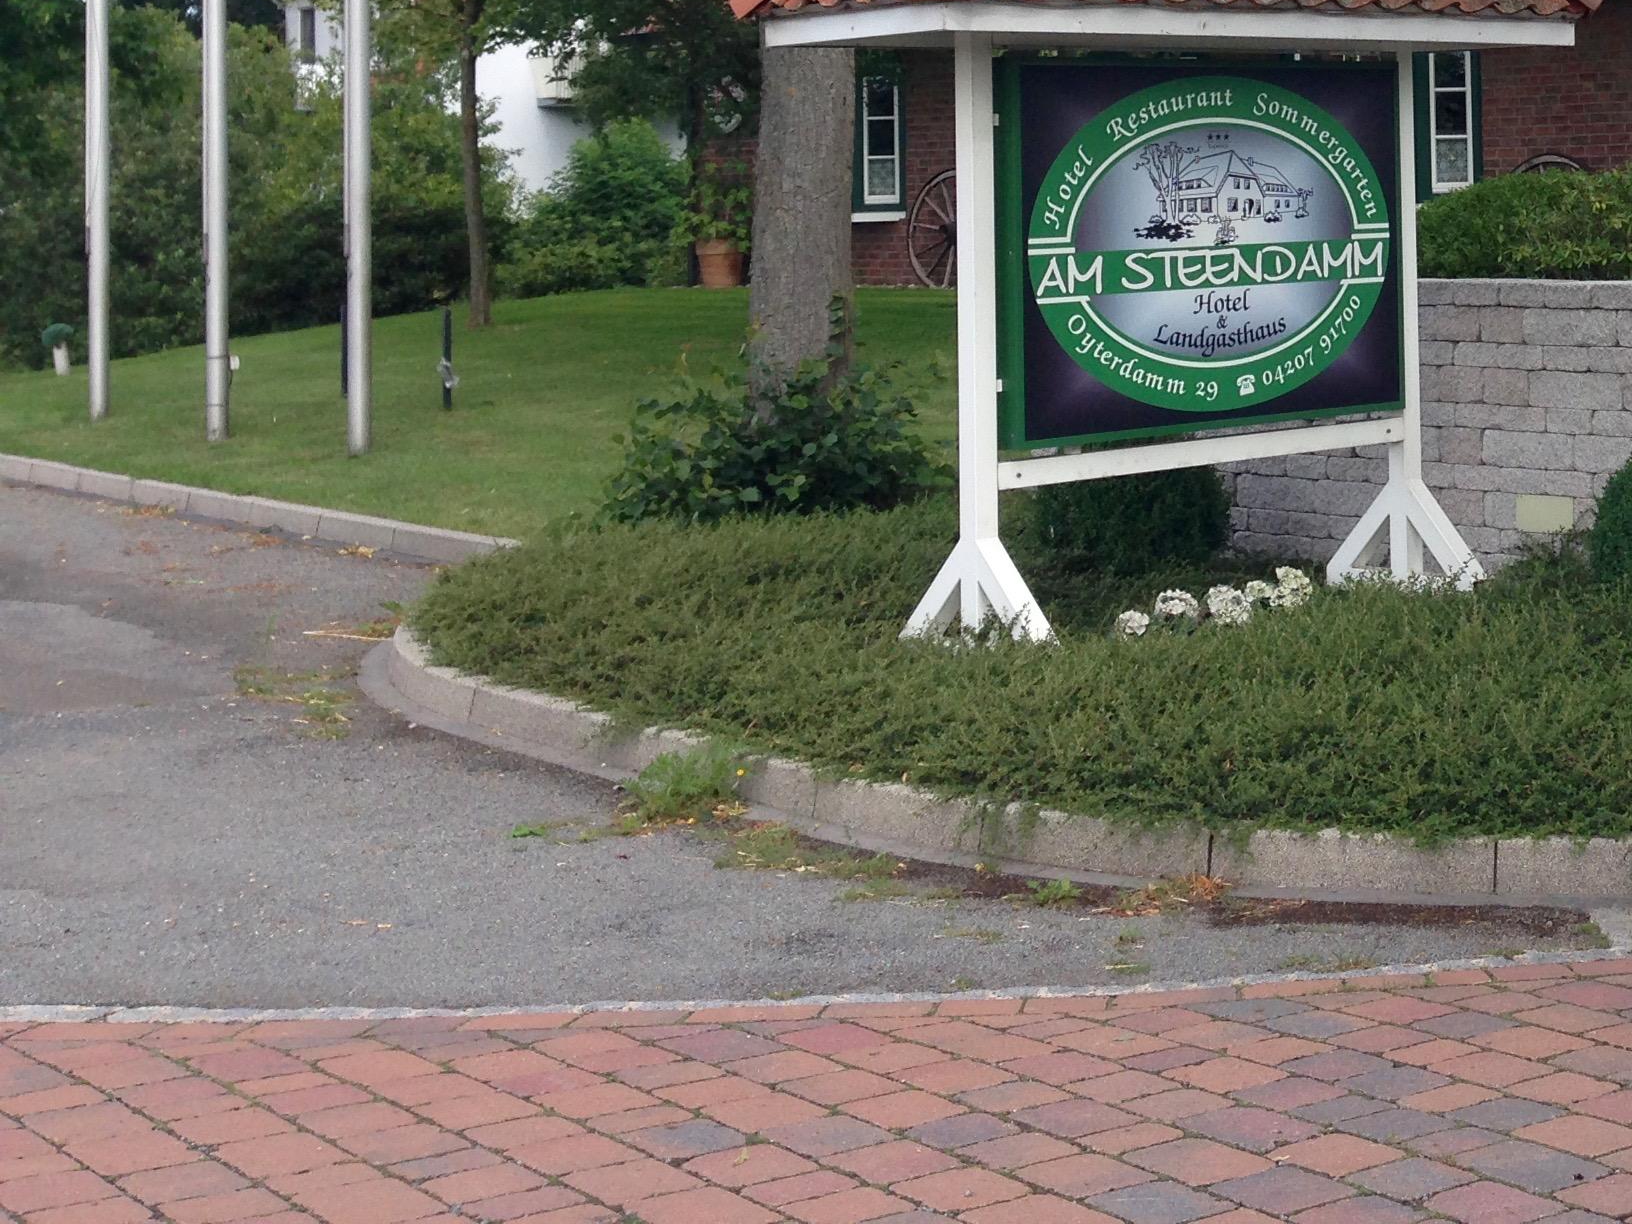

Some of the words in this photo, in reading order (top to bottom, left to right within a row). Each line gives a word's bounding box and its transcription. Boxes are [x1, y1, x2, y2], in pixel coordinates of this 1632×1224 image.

[1043, 143, 1095, 230] Hotel
[1106, 88, 1233, 143] Restaurant
[1253, 92, 1377, 219] Sommergarten
[1036, 254, 1104, 297] AM
[1121, 241, 1385, 290] STEENDAMM
[1193, 288, 1251, 315] Hotel
[1216, 314, 1228, 329] &
[1067, 314, 1187, 395] Oyterdamm
[1195, 381, 1219, 401] 29
[1262, 347, 1315, 387] 04207
[1319, 295, 1361, 354] 91700
[1153, 316, 1287, 358] Landgasthaus
